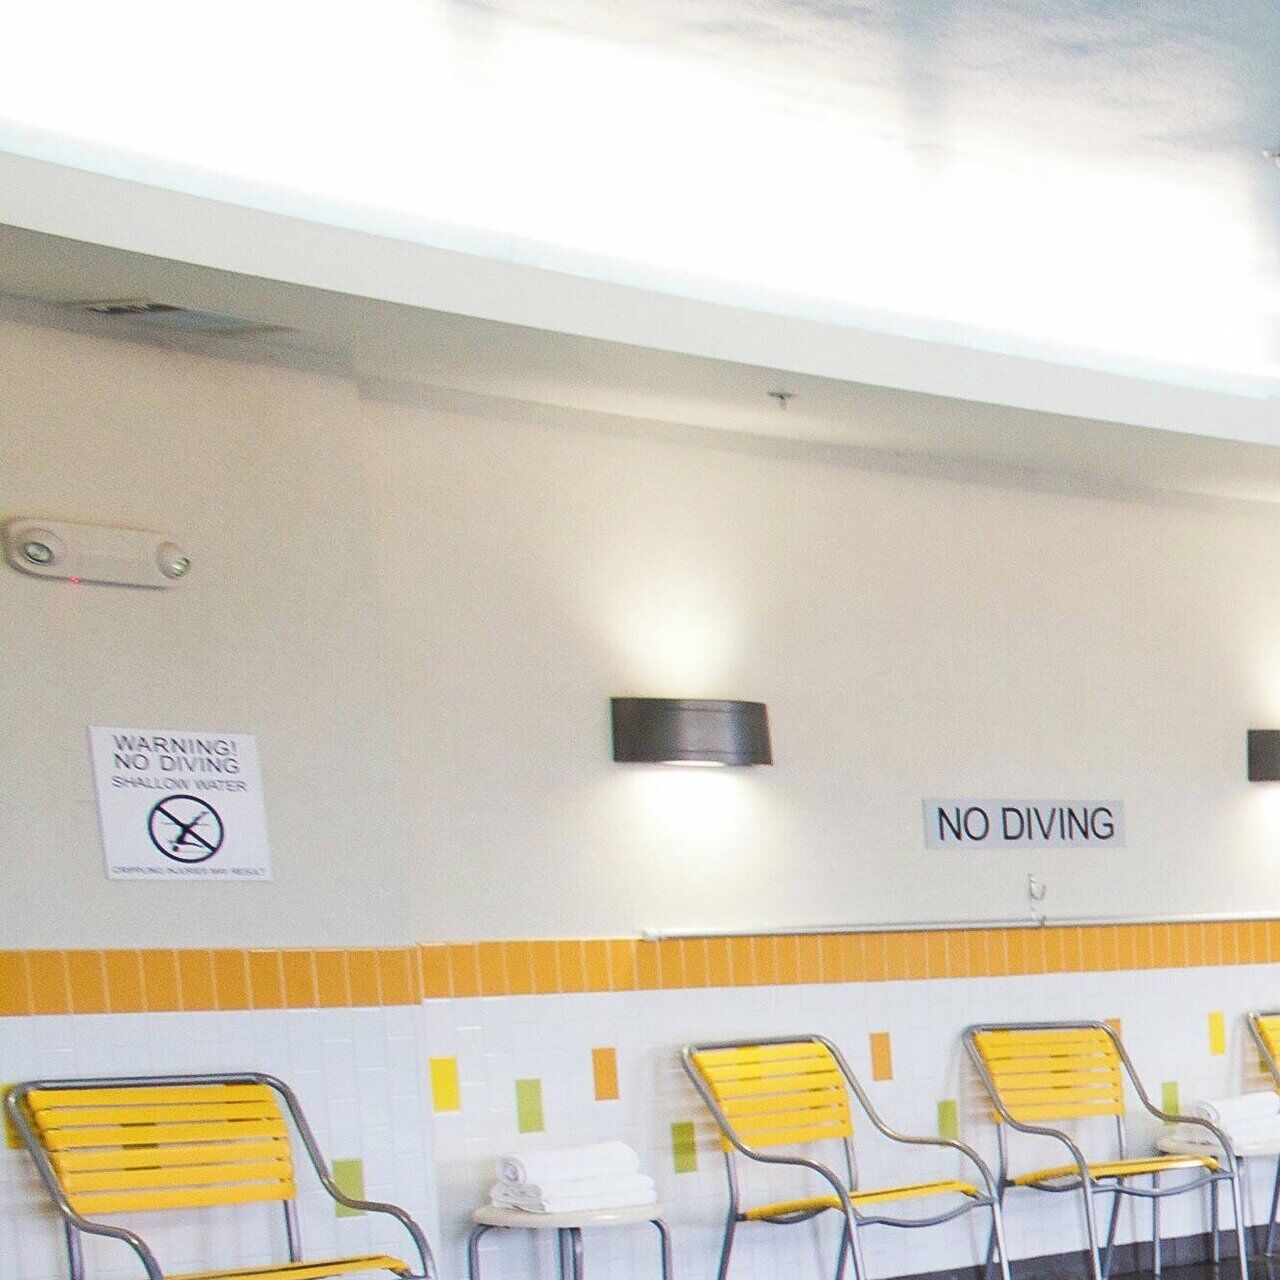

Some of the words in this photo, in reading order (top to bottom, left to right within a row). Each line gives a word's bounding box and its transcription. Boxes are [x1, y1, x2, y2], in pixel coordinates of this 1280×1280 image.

[112, 734, 237, 756] WARNING!
[113, 752, 149, 771] NO
[160, 754, 240, 774] DIVING
[111, 775, 191, 790] SHALLOW
[194, 779, 248, 792] WATER
[937, 806, 990, 842] NO
[1001, 806, 1115, 841] DIVING
